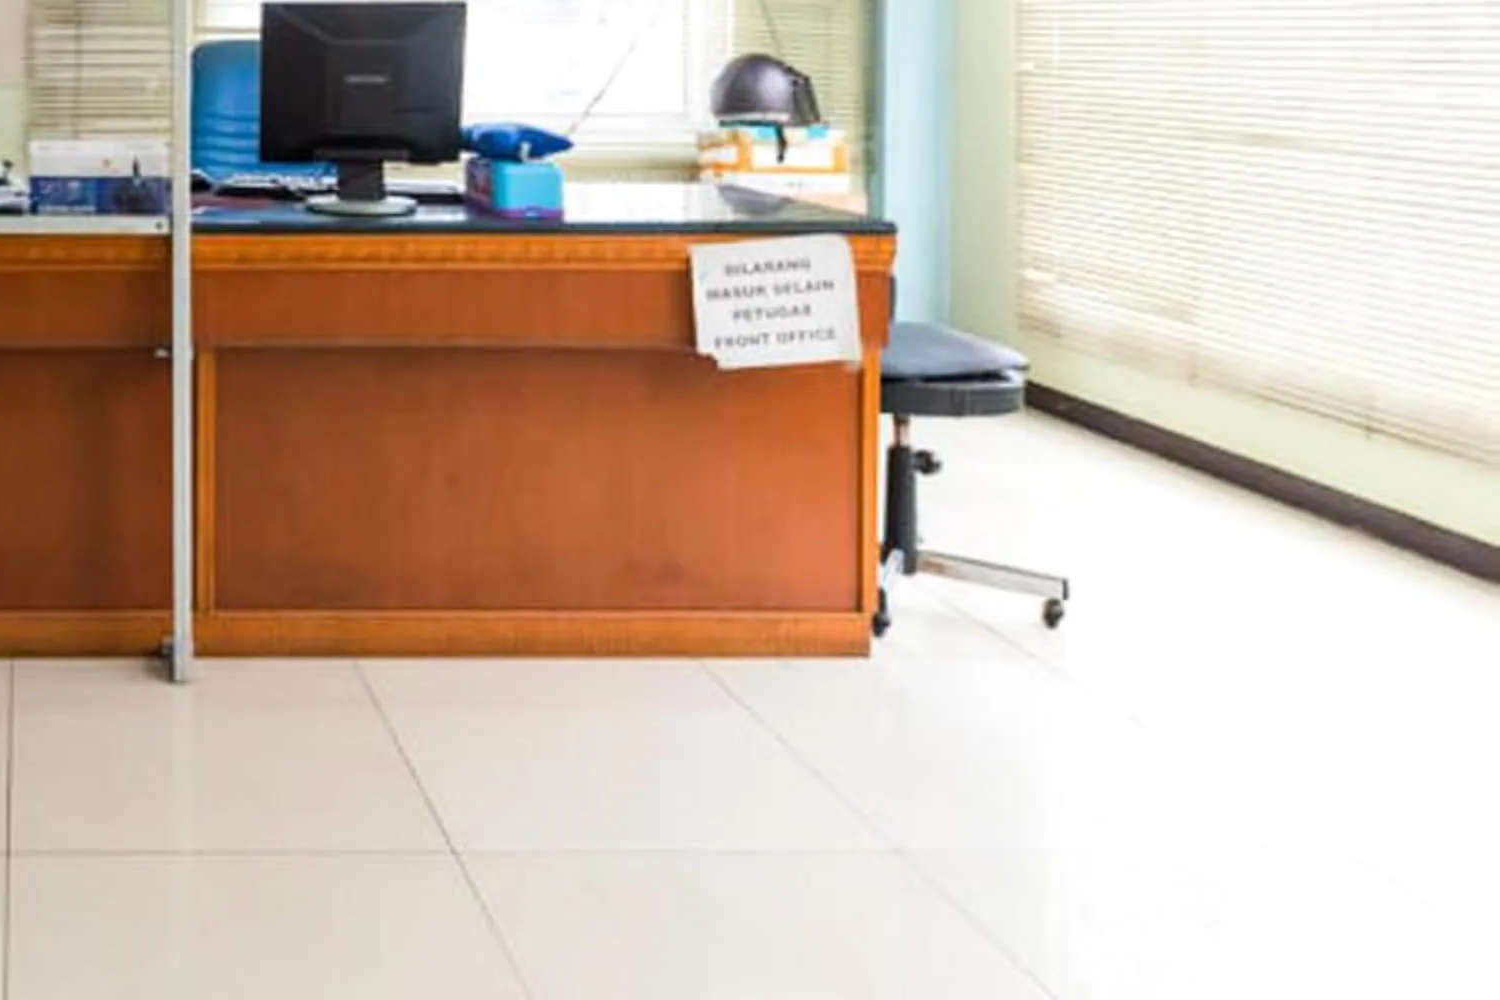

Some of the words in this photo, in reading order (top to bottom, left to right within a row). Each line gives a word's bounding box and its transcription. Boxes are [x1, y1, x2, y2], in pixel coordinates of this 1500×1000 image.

[724, 258, 811, 276] DILARANG
[706, 285, 766, 300] MASUK
[773, 279, 835, 296] SELAIN
[732, 304, 811, 322] PETUGAS
[714, 332, 770, 349] FRONT
[776, 327, 836, 344] OFFICE
